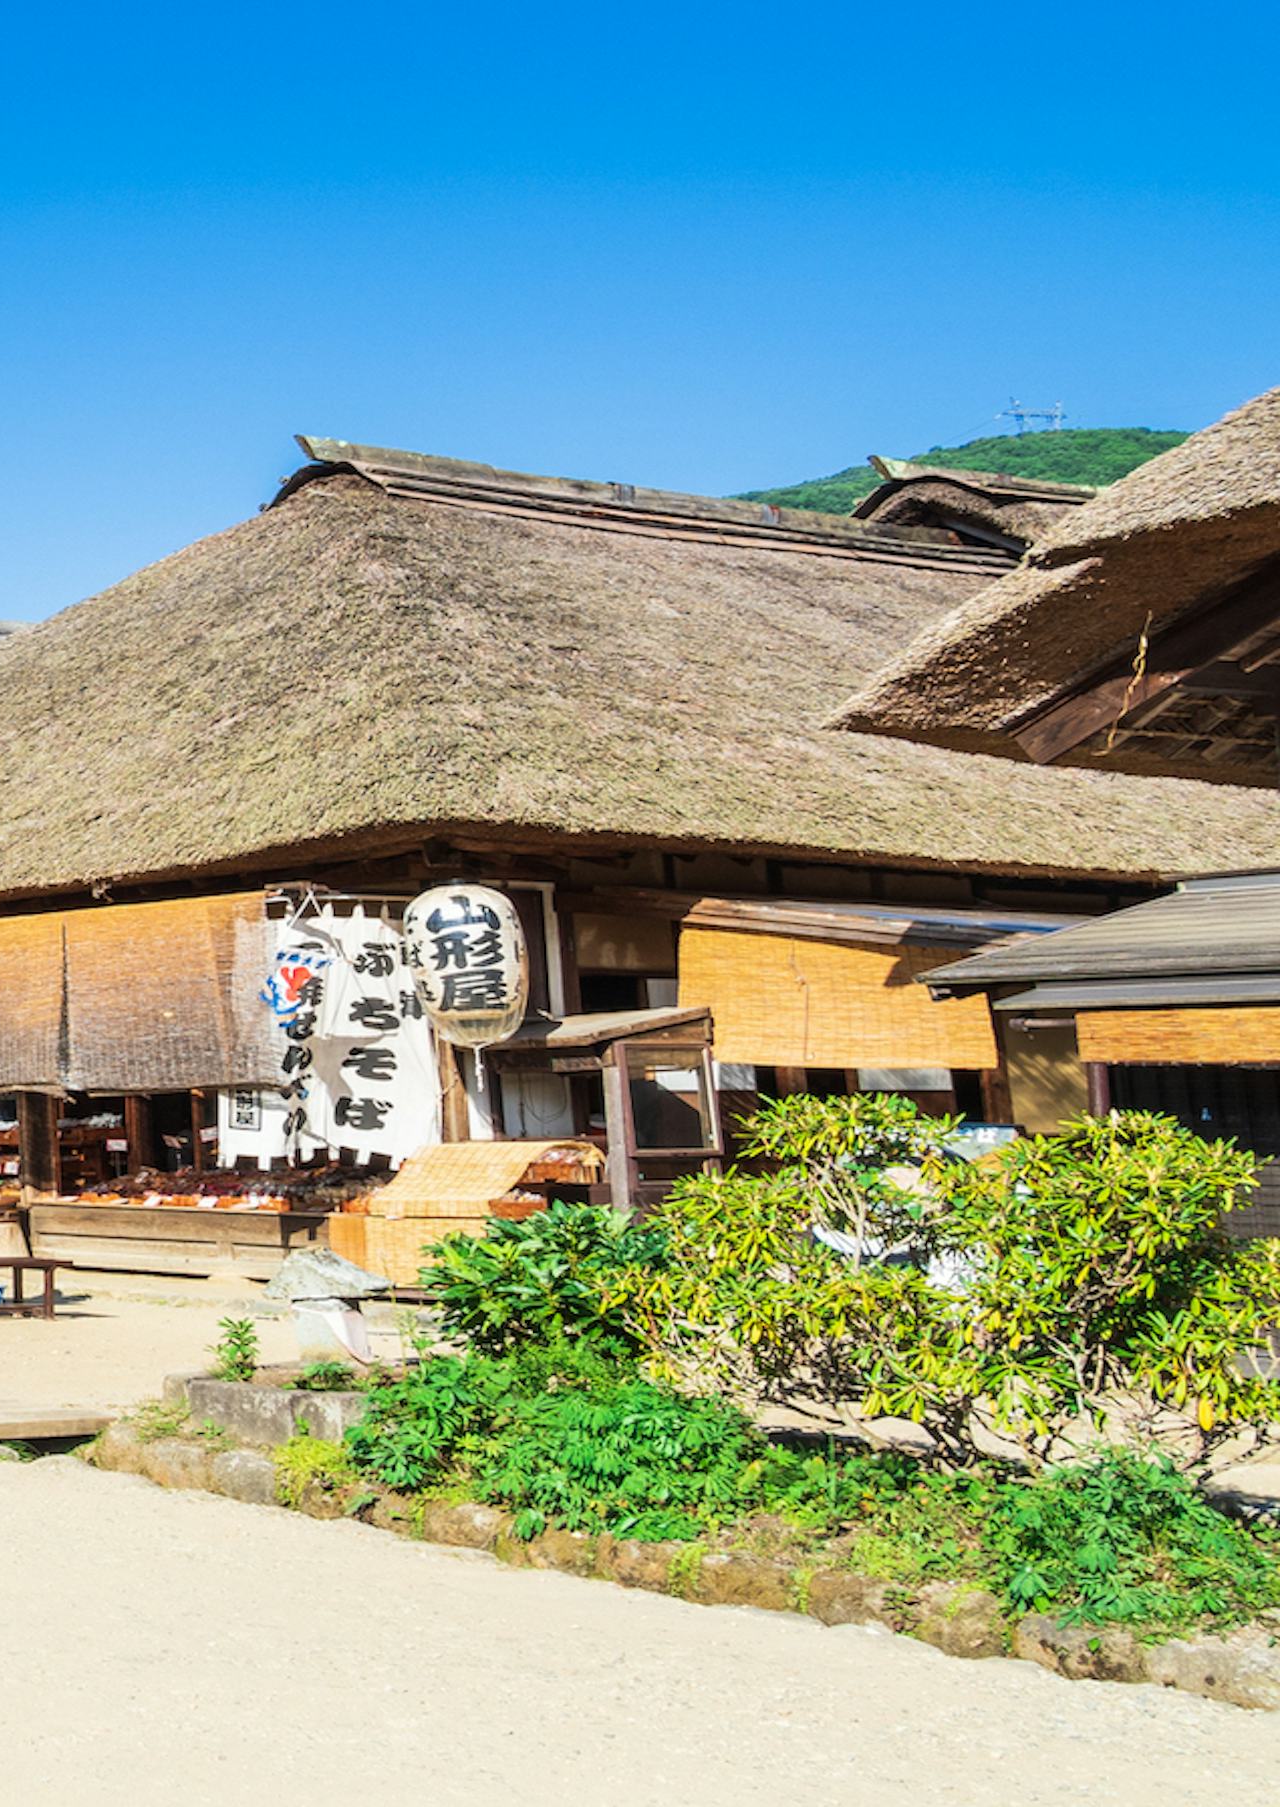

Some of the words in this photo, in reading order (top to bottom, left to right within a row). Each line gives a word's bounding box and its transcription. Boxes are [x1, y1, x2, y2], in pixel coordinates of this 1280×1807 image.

[426, 894, 510, 1011] 山形屋
[334, 941, 399, 1131] ぶちそば
